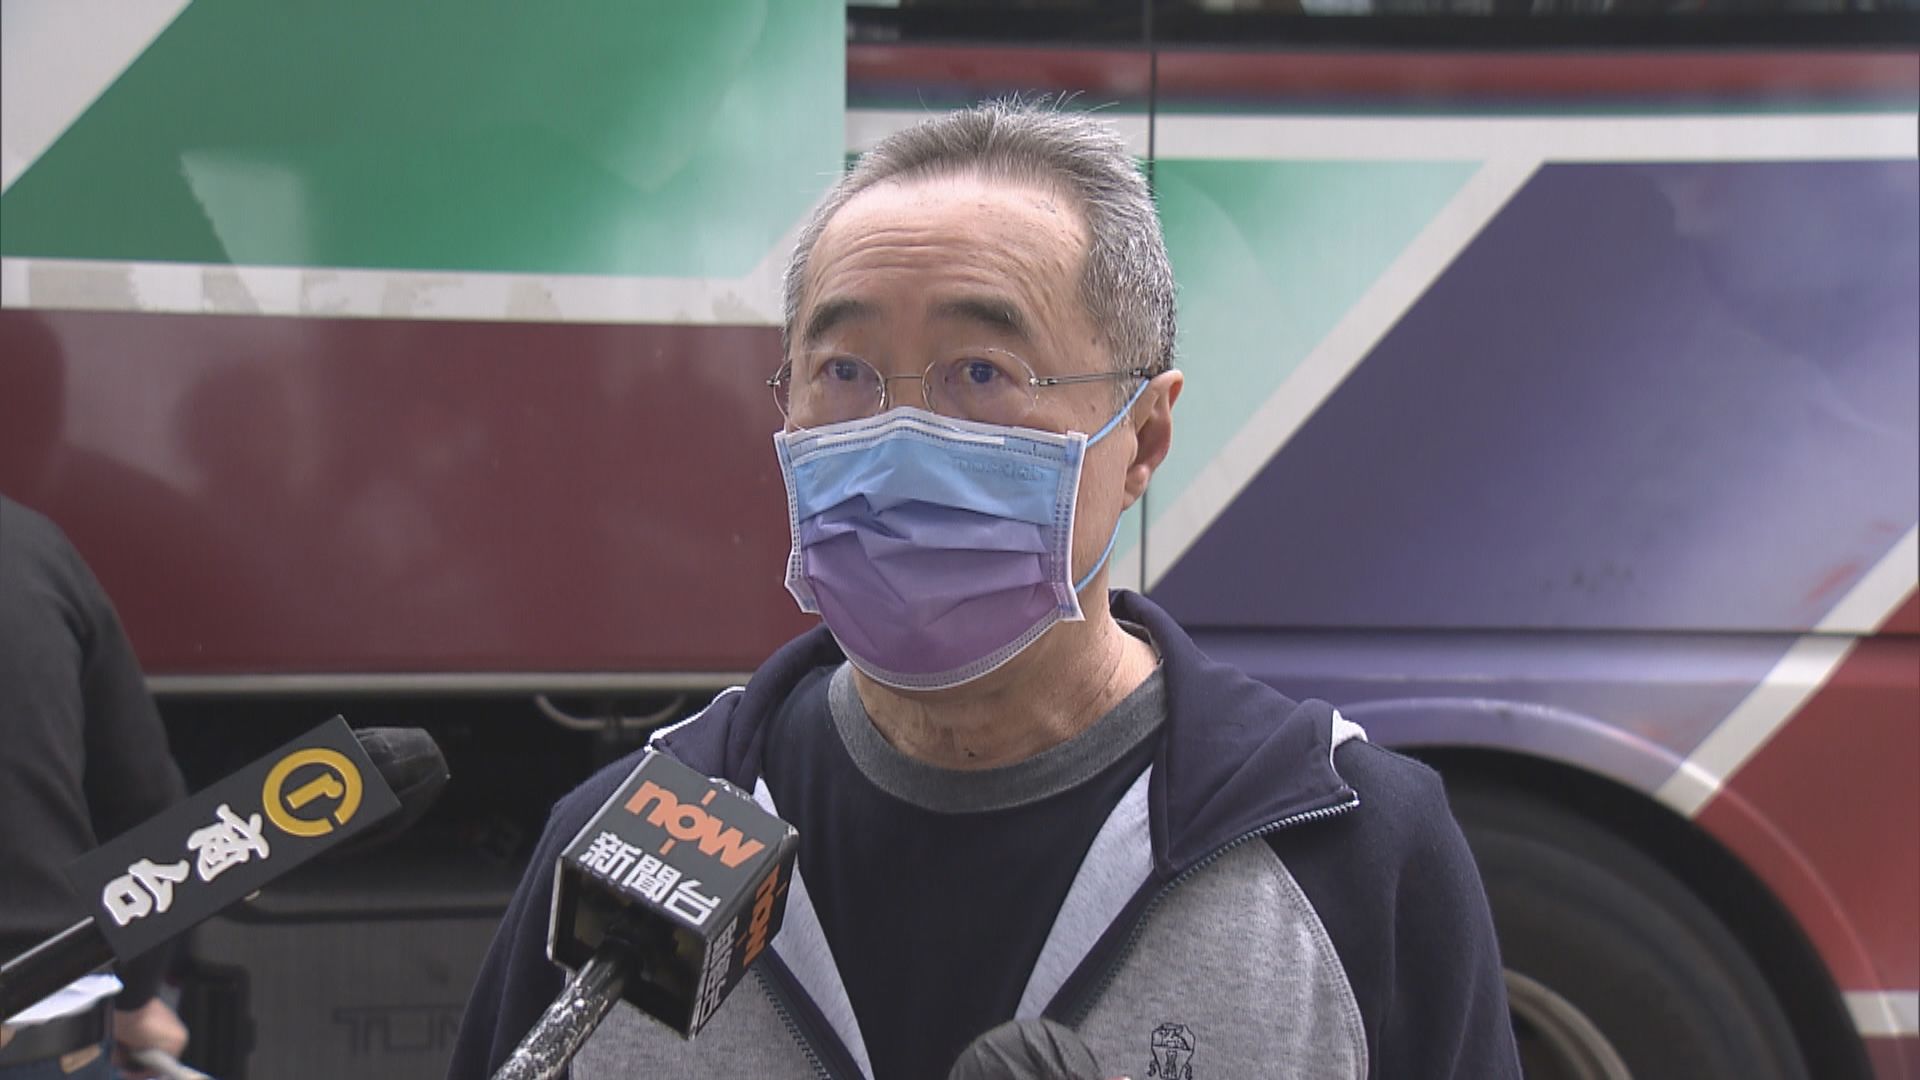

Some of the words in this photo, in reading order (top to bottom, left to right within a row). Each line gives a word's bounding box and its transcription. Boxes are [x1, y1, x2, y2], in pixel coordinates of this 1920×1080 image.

[103, 803, 270, 926] 商台
[624, 780, 765, 868] now
[579, 831, 721, 926] 新聞台
